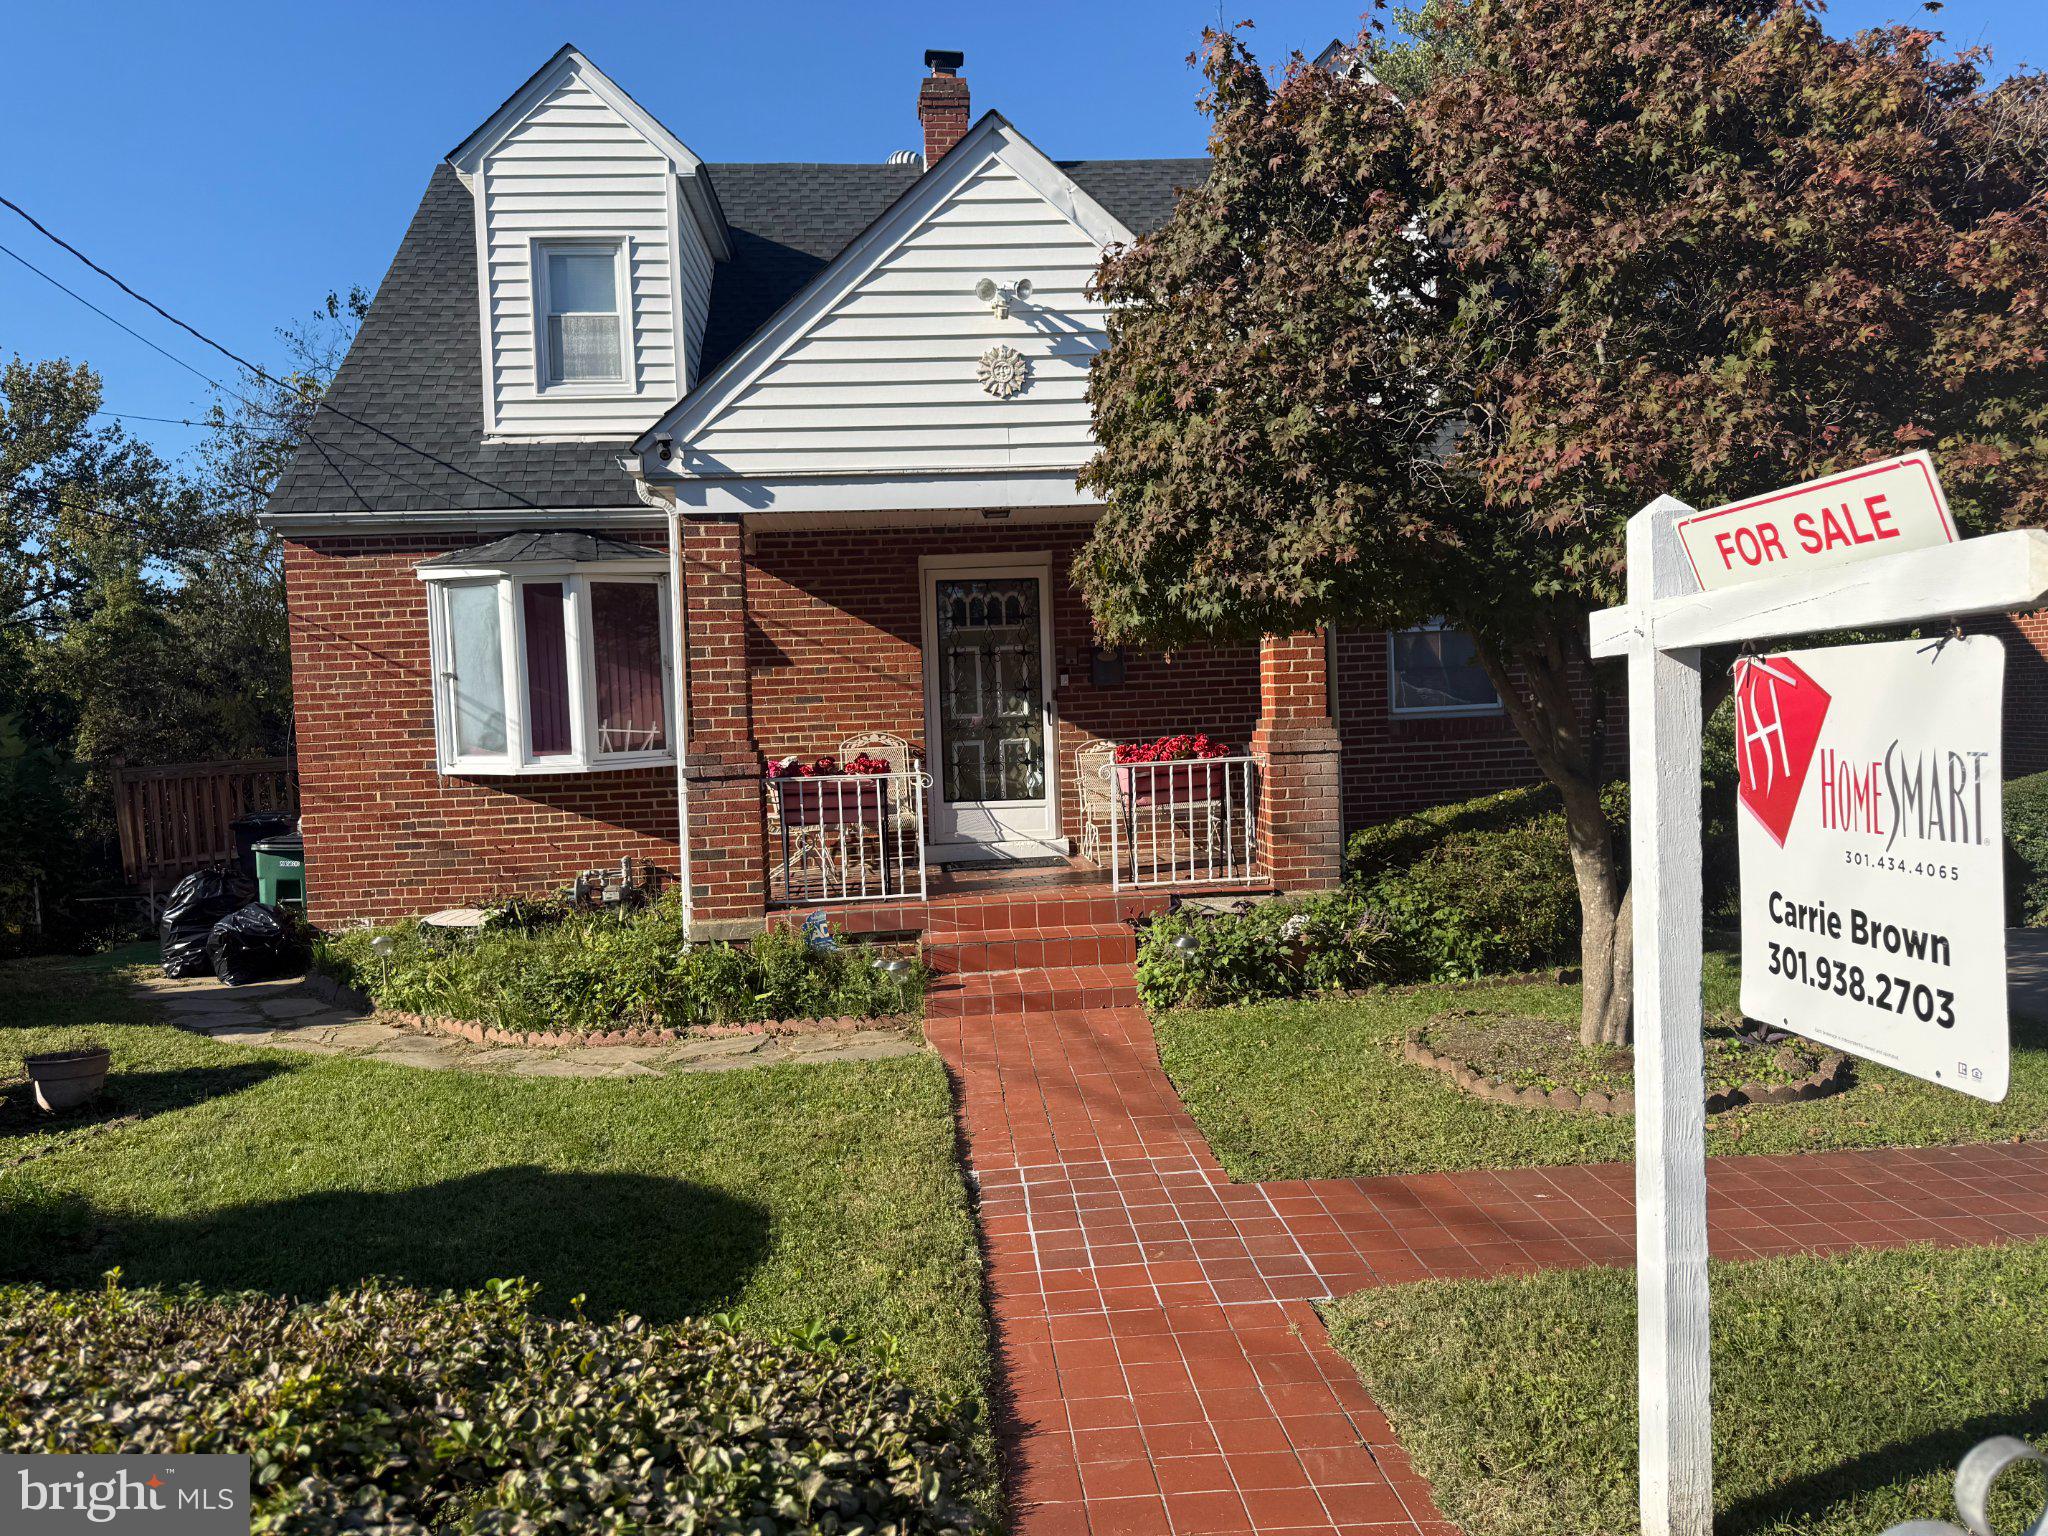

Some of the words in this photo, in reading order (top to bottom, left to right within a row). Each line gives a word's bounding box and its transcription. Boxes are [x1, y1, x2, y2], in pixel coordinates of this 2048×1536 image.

[1714, 522, 1788, 570] FOR
[1793, 494, 1901, 554] SALE
[1845, 851, 1960, 881] 301.434.4065
[1768, 890, 1842, 939] Carrie
[1850, 908, 1951, 966] Brown
[1768, 941, 1956, 1029] 301.938.2703
